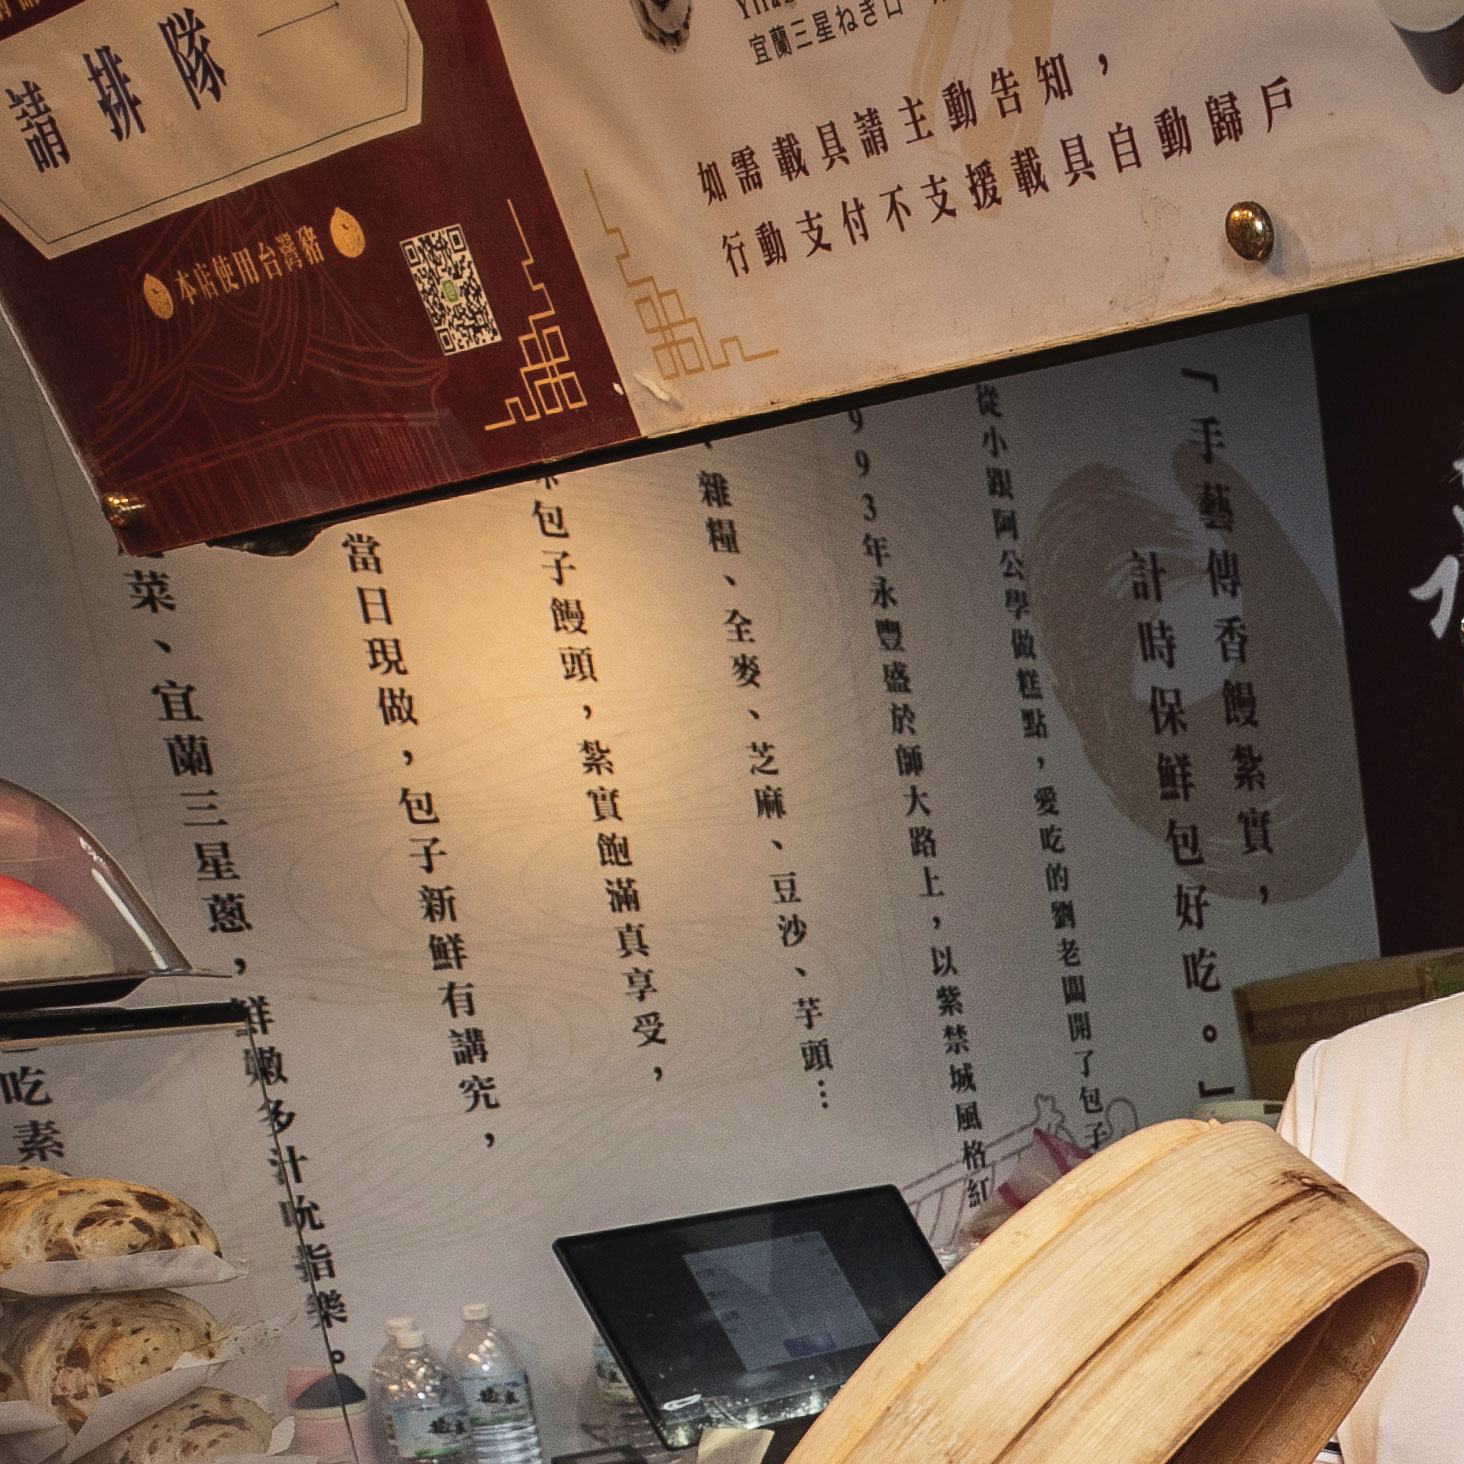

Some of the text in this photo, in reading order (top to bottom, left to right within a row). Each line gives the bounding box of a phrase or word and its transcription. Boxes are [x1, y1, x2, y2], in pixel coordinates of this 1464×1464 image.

[5, 7, 228, 174] 請排隊
[721, 75, 1295, 278] 行動支付不支援載具自動歸戶
[174, 224, 325, 306] 本店使用台灣豬
[532, 475, 668, 1082] 包子饅頭，紮實飽滿真享受，
[118, 545, 347, 1364] 菜、宜蘭三星蔥，鮮嫩多汁吮指樂。
